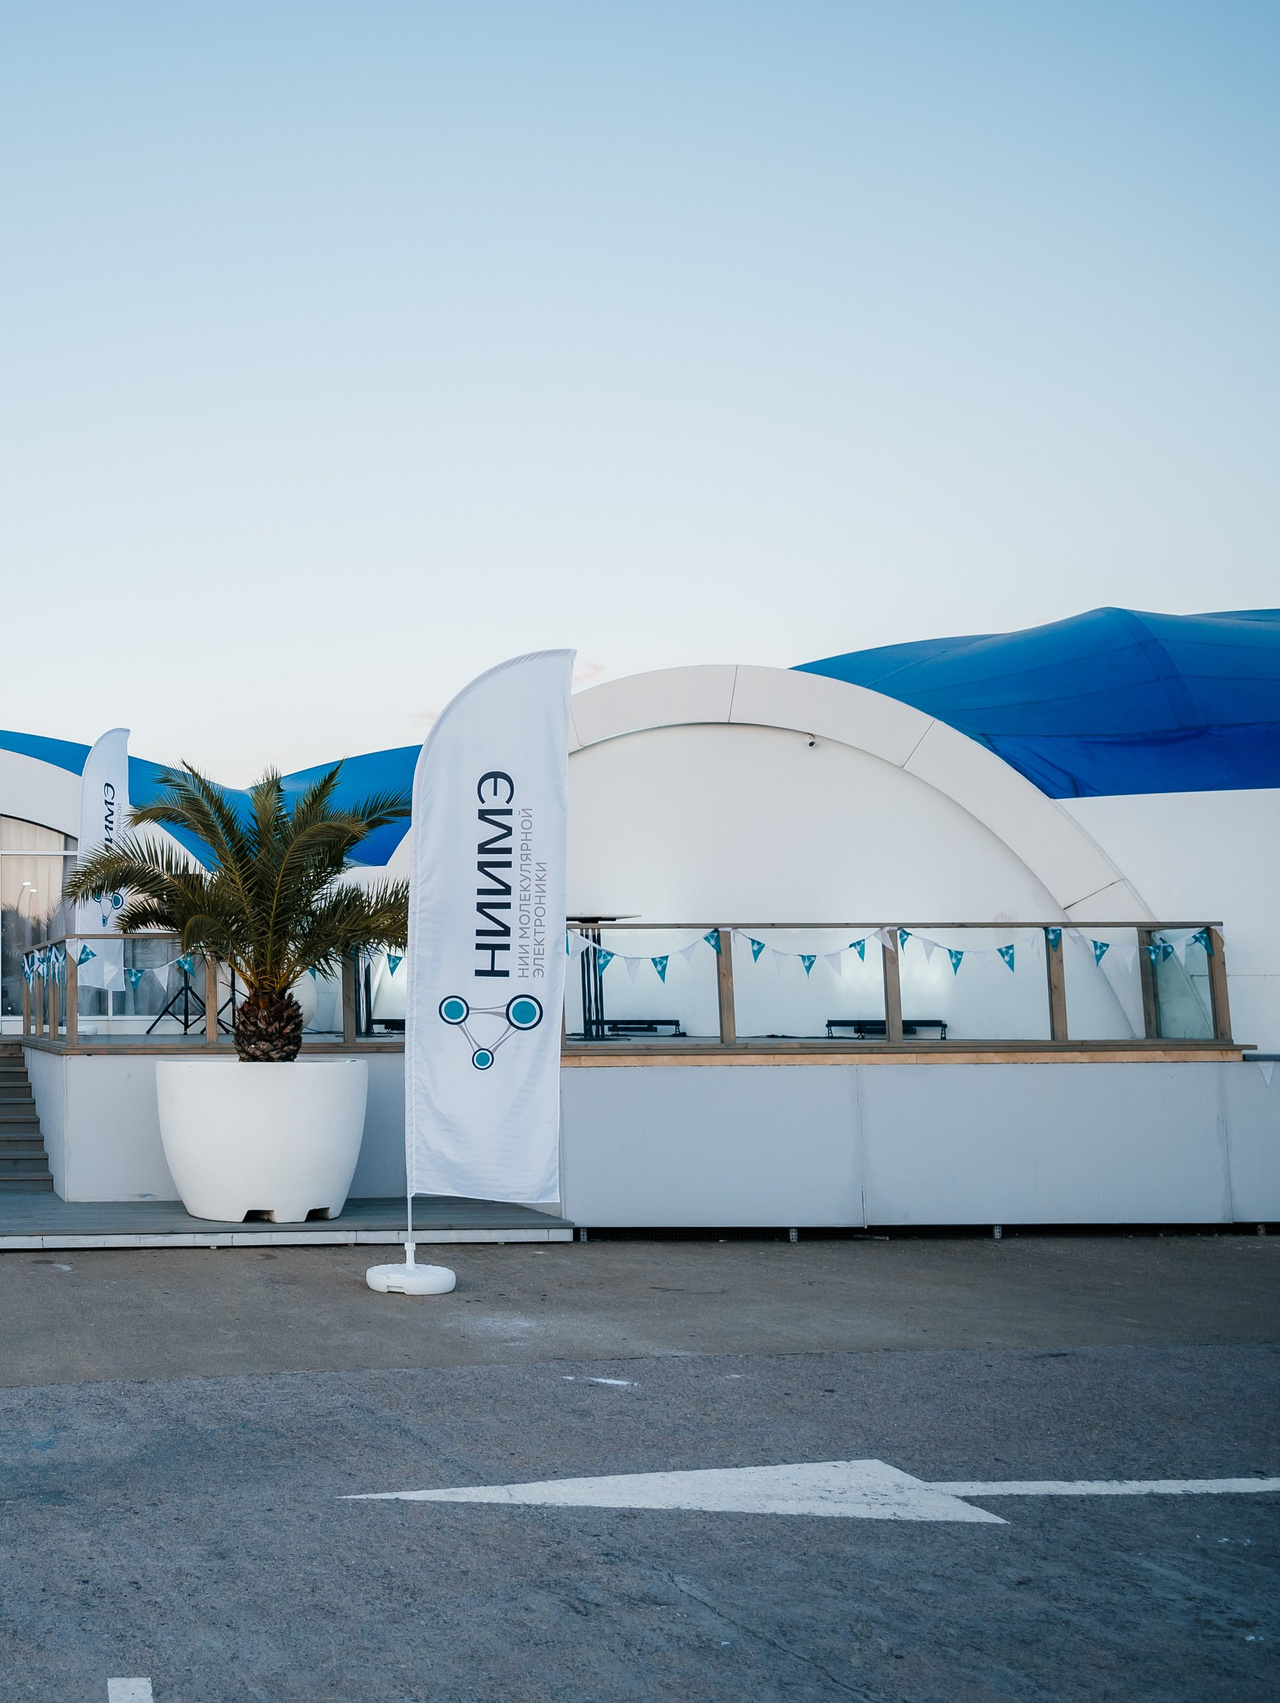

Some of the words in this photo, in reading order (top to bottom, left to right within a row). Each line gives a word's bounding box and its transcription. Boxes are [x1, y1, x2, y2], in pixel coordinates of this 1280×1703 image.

[103, 782, 116, 844] ИМЭ
[474, 770, 515, 978] НИИМЭ
[517, 808, 533, 939] МОЛЕКУЛЯРНОЙ
[532, 862, 547, 978] ЭЛЕКТРОНИКИ
[517, 944, 530, 978] НИИ
